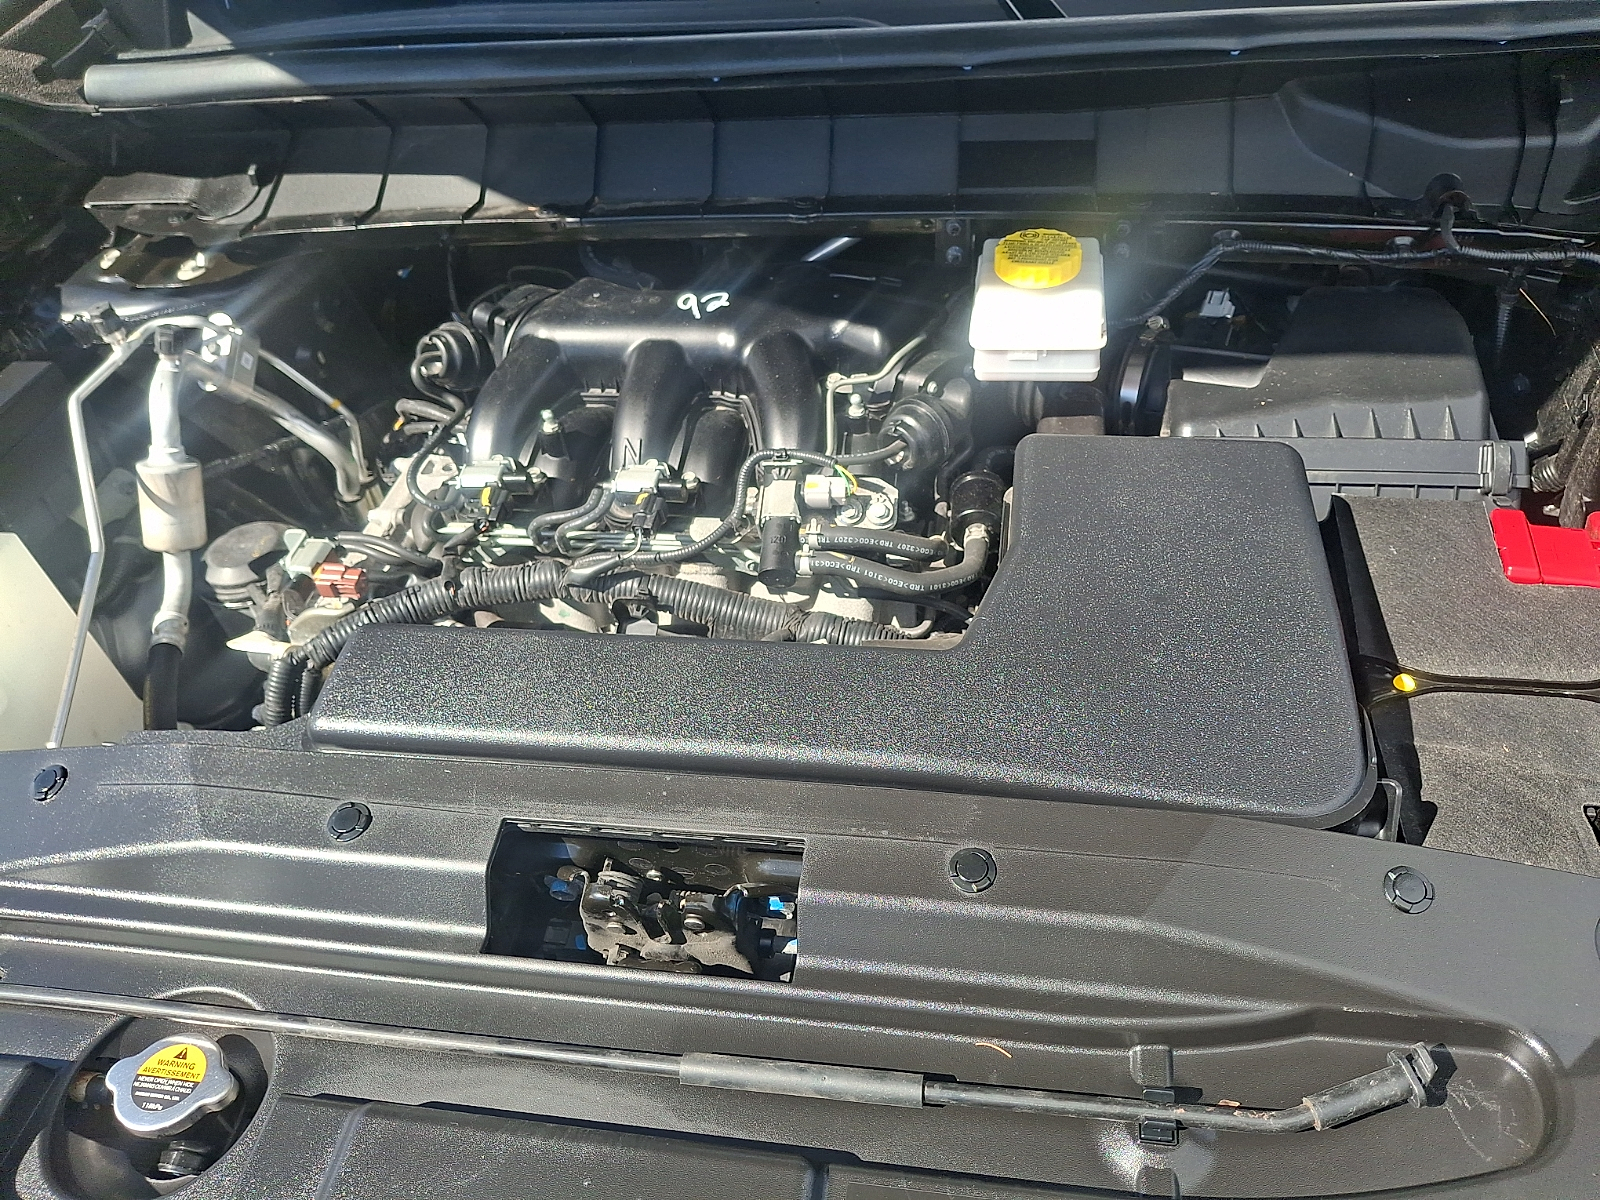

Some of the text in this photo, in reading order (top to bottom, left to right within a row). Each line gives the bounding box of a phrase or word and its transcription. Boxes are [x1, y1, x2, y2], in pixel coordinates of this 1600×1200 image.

[677, 292, 730, 320] 92
[622, 437, 643, 468] N
[811, 560, 860, 574] TRD>ECO<31
[157, 1059, 196, 1071] WARNING
[142, 1067, 200, 1079] AVERTISSEMENT
